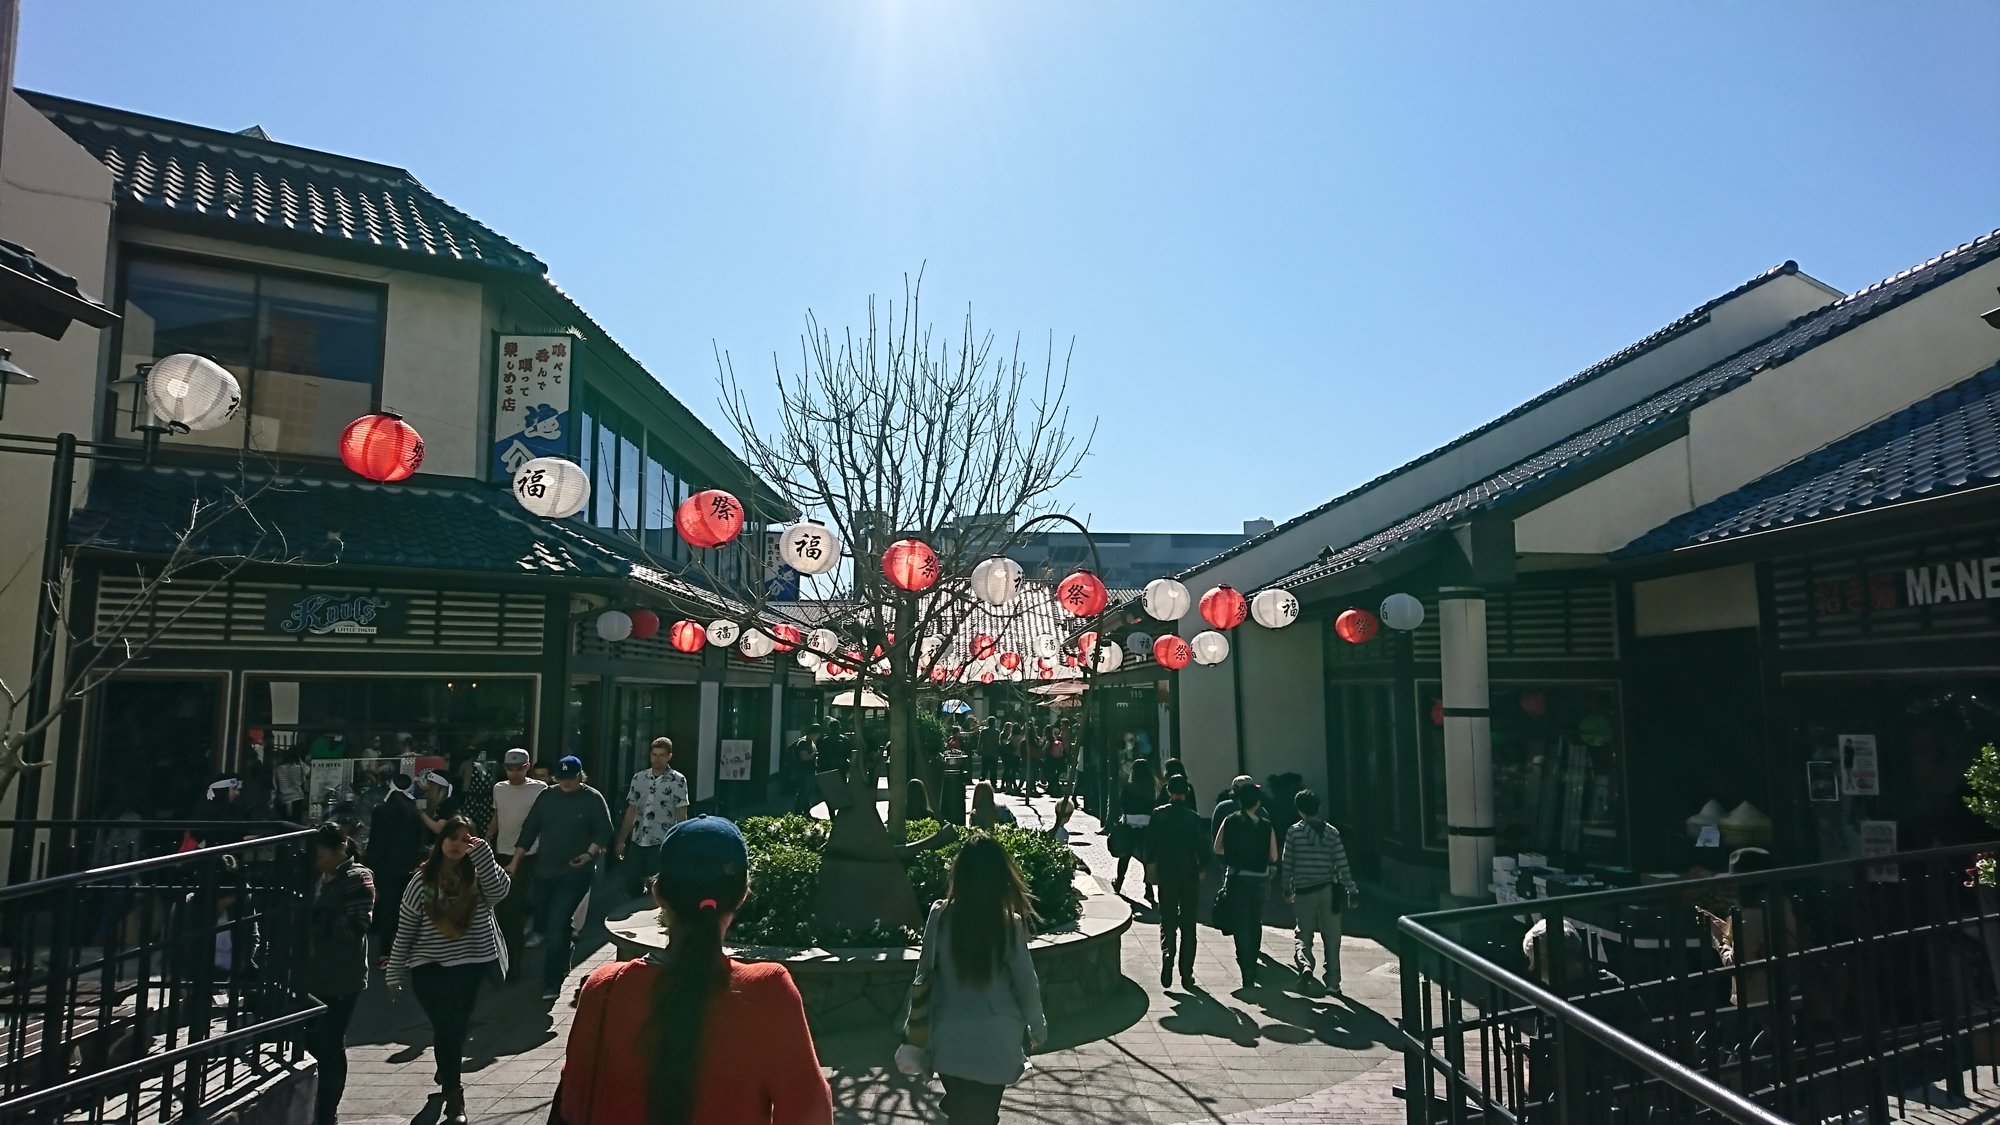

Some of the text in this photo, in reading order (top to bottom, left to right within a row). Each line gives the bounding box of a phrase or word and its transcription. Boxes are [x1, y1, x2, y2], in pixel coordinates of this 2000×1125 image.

[518, 469, 546, 498] 福
[711, 496, 738, 520] 祭
[795, 534, 822, 560] 福
[919, 555, 938, 578] 祭
[1905, 557, 2000, 606] MANE
[1064, 584, 1089, 605] 祭
[1282, 599, 1297, 617] 福
[716, 626, 731, 640] 福
[741, 635, 752, 651] 福
[1174, 645, 1188, 660] 祭
[1130, 690, 1143, 698] 115
